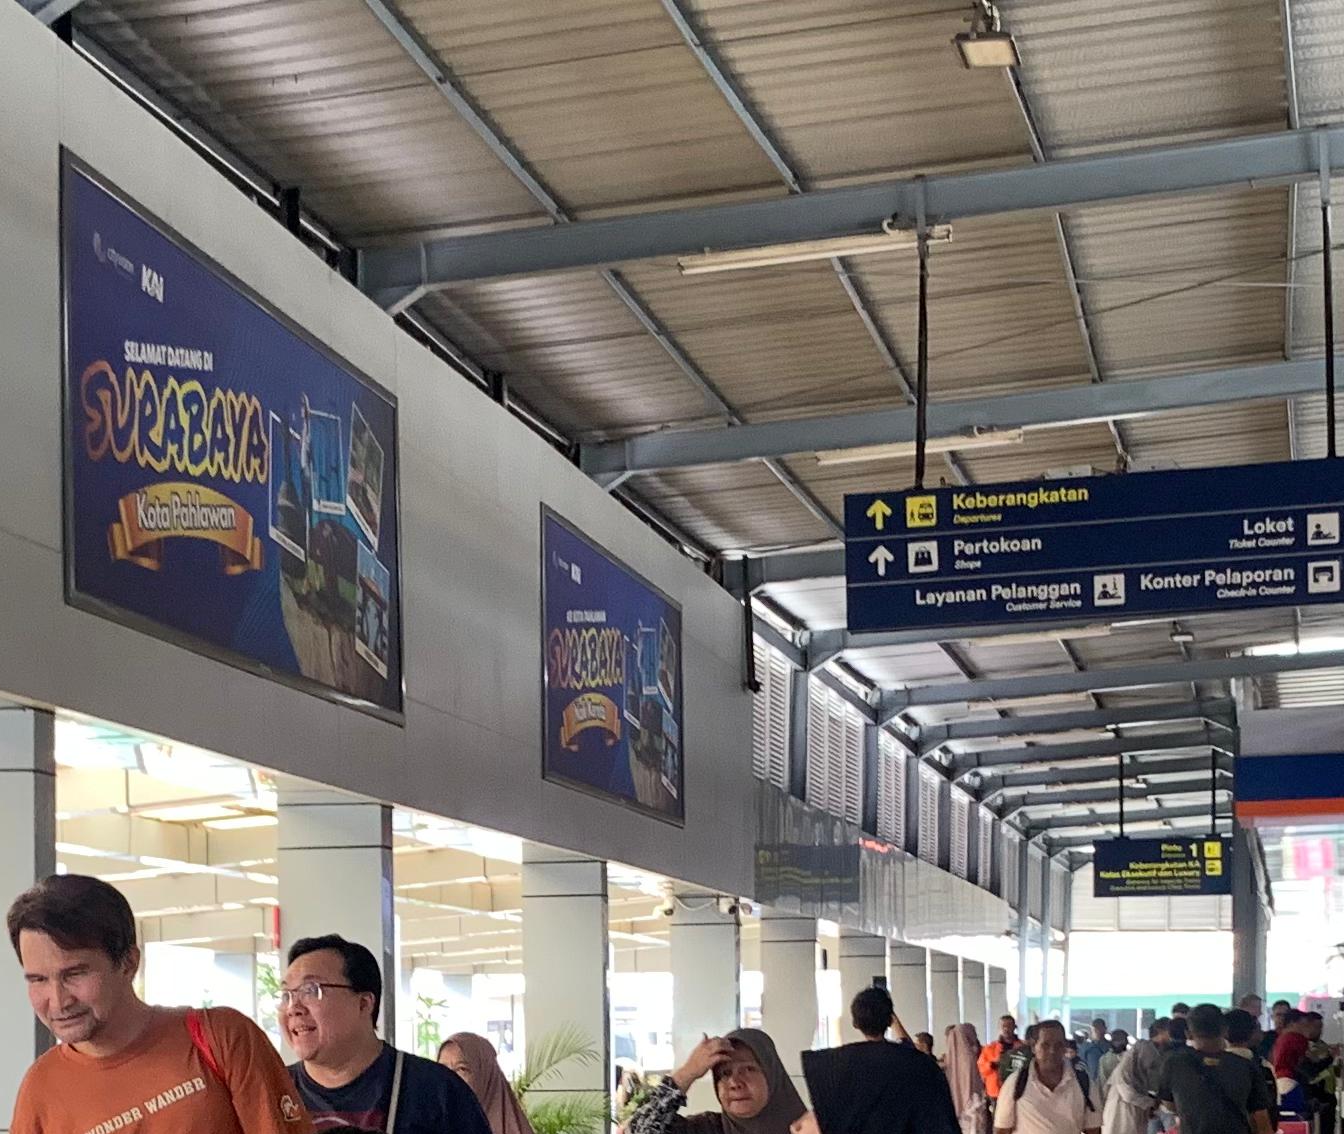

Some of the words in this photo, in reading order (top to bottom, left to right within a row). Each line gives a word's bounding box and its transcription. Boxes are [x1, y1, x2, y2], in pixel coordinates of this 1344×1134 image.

[124, 339, 167, 366] SELAMAT
[167, 345, 203, 370] DATANG
[203, 352, 214, 372] DI
[81, 360, 269, 484] SURABAYA
[952, 487, 1089, 510] Keberangkatan
[137, 491, 171, 530] Kota
[171, 491, 236, 531] Pahlawan
[953, 513, 1002, 524] Departures
[1243, 517, 1295, 535] Loket
[954, 536, 1042, 556] Pertokoan
[1229, 538, 1256, 549] Ticket
[1258, 536, 1295, 548] Counter
[954, 559, 982, 570] Shops
[1140, 573, 1201, 591] Konter
[1205, 566, 1295, 587] Pelaporan
[915, 586, 987, 607] Layanan
[991, 581, 1082, 601] Pelanggan
[1259, 584, 1296, 597] Counter
[1006, 600, 1048, 612] Customer
[1050, 598, 1082, 610] Service
[144, 1077, 206, 1115] WANDER
